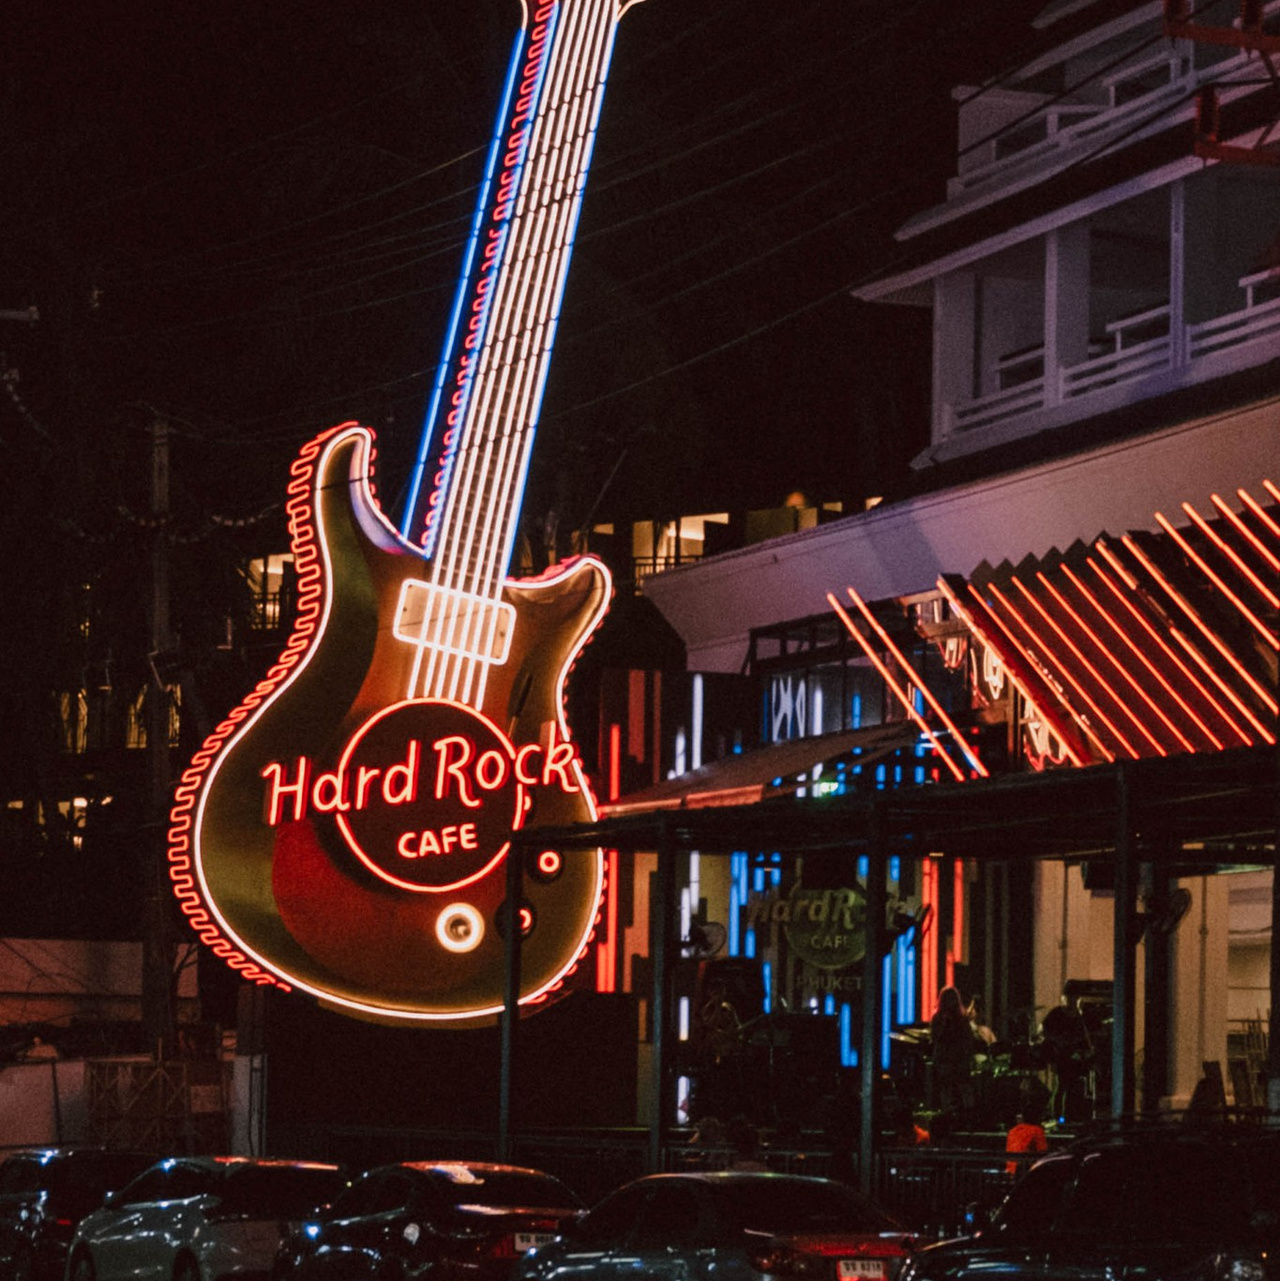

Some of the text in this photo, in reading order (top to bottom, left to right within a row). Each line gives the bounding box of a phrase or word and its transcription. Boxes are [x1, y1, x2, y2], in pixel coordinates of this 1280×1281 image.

[262, 720, 579, 826] Hard Rock
[397, 822, 479, 858] CAFE
